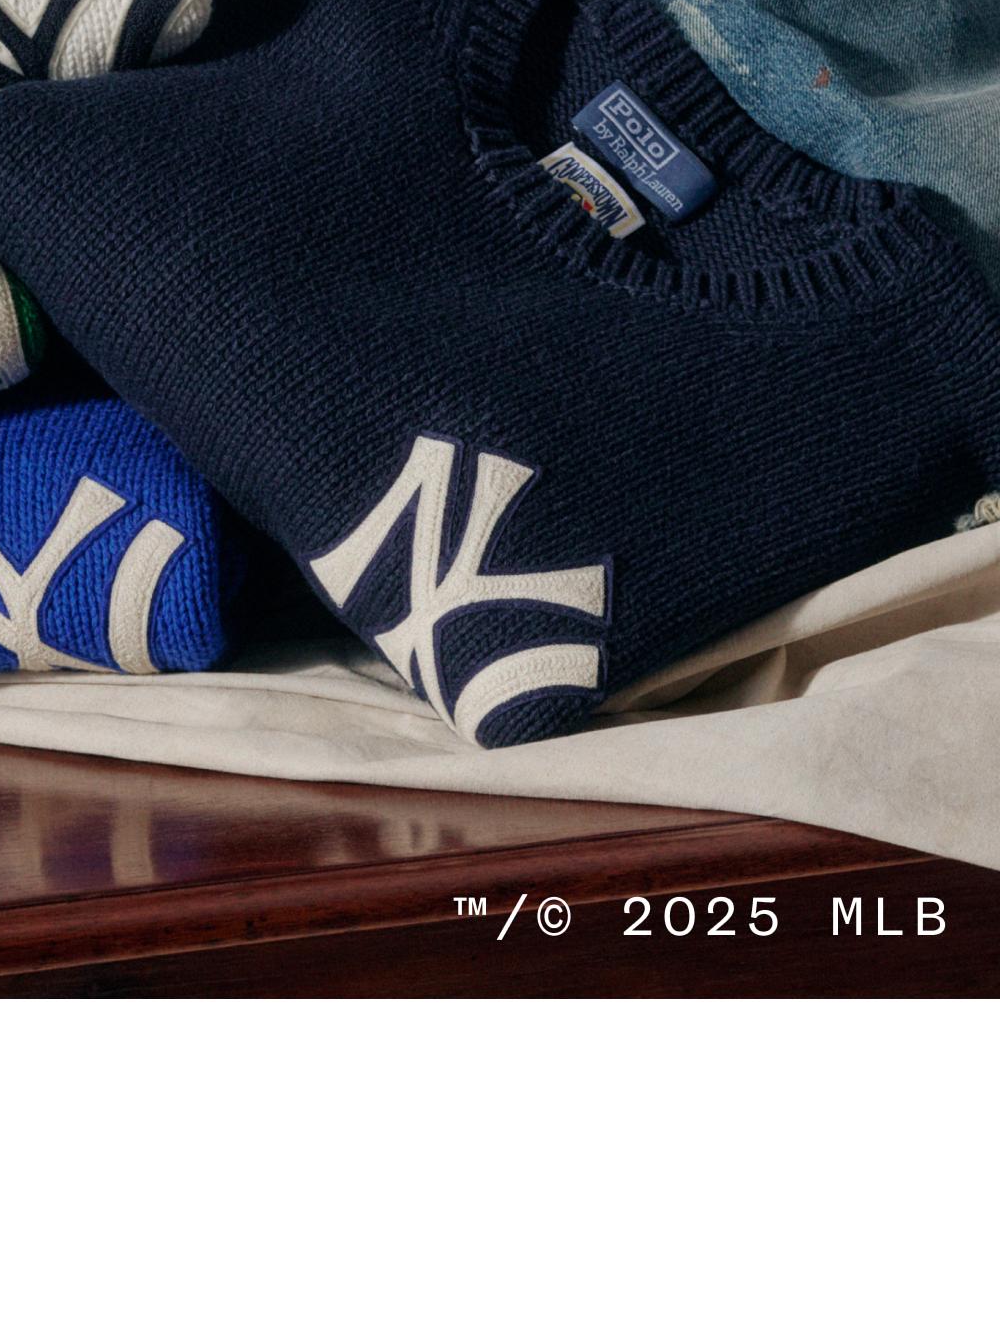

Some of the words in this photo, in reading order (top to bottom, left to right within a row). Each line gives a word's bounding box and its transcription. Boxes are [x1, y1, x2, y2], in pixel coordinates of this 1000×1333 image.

[608, 97, 666, 159] Polo
[549, 156, 628, 230] COOPERSTOWN
[593, 118, 614, 141] by
[609, 136, 651, 180] Ralph
[641, 170, 686, 213] Lauren
